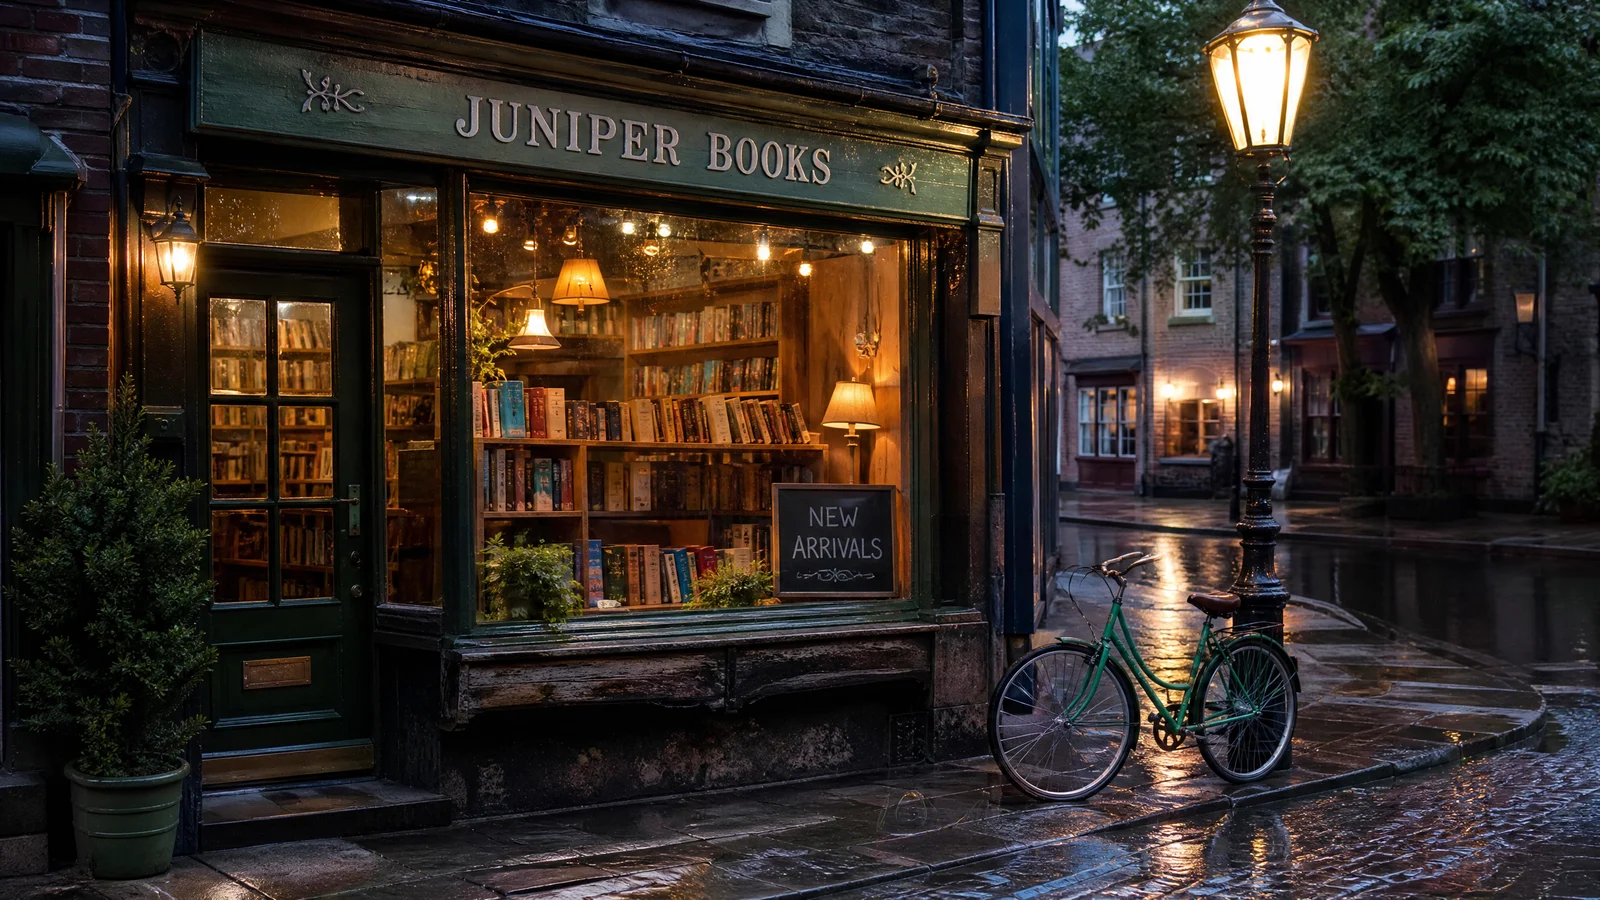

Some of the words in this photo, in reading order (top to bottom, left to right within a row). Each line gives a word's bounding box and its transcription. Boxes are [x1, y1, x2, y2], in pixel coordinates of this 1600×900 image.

[455, 95, 681, 166] JUNIPER
[706, 132, 831, 185] BOOKS
[809, 506, 858, 527] NEW
[792, 535, 882, 560] ARRIVALS
